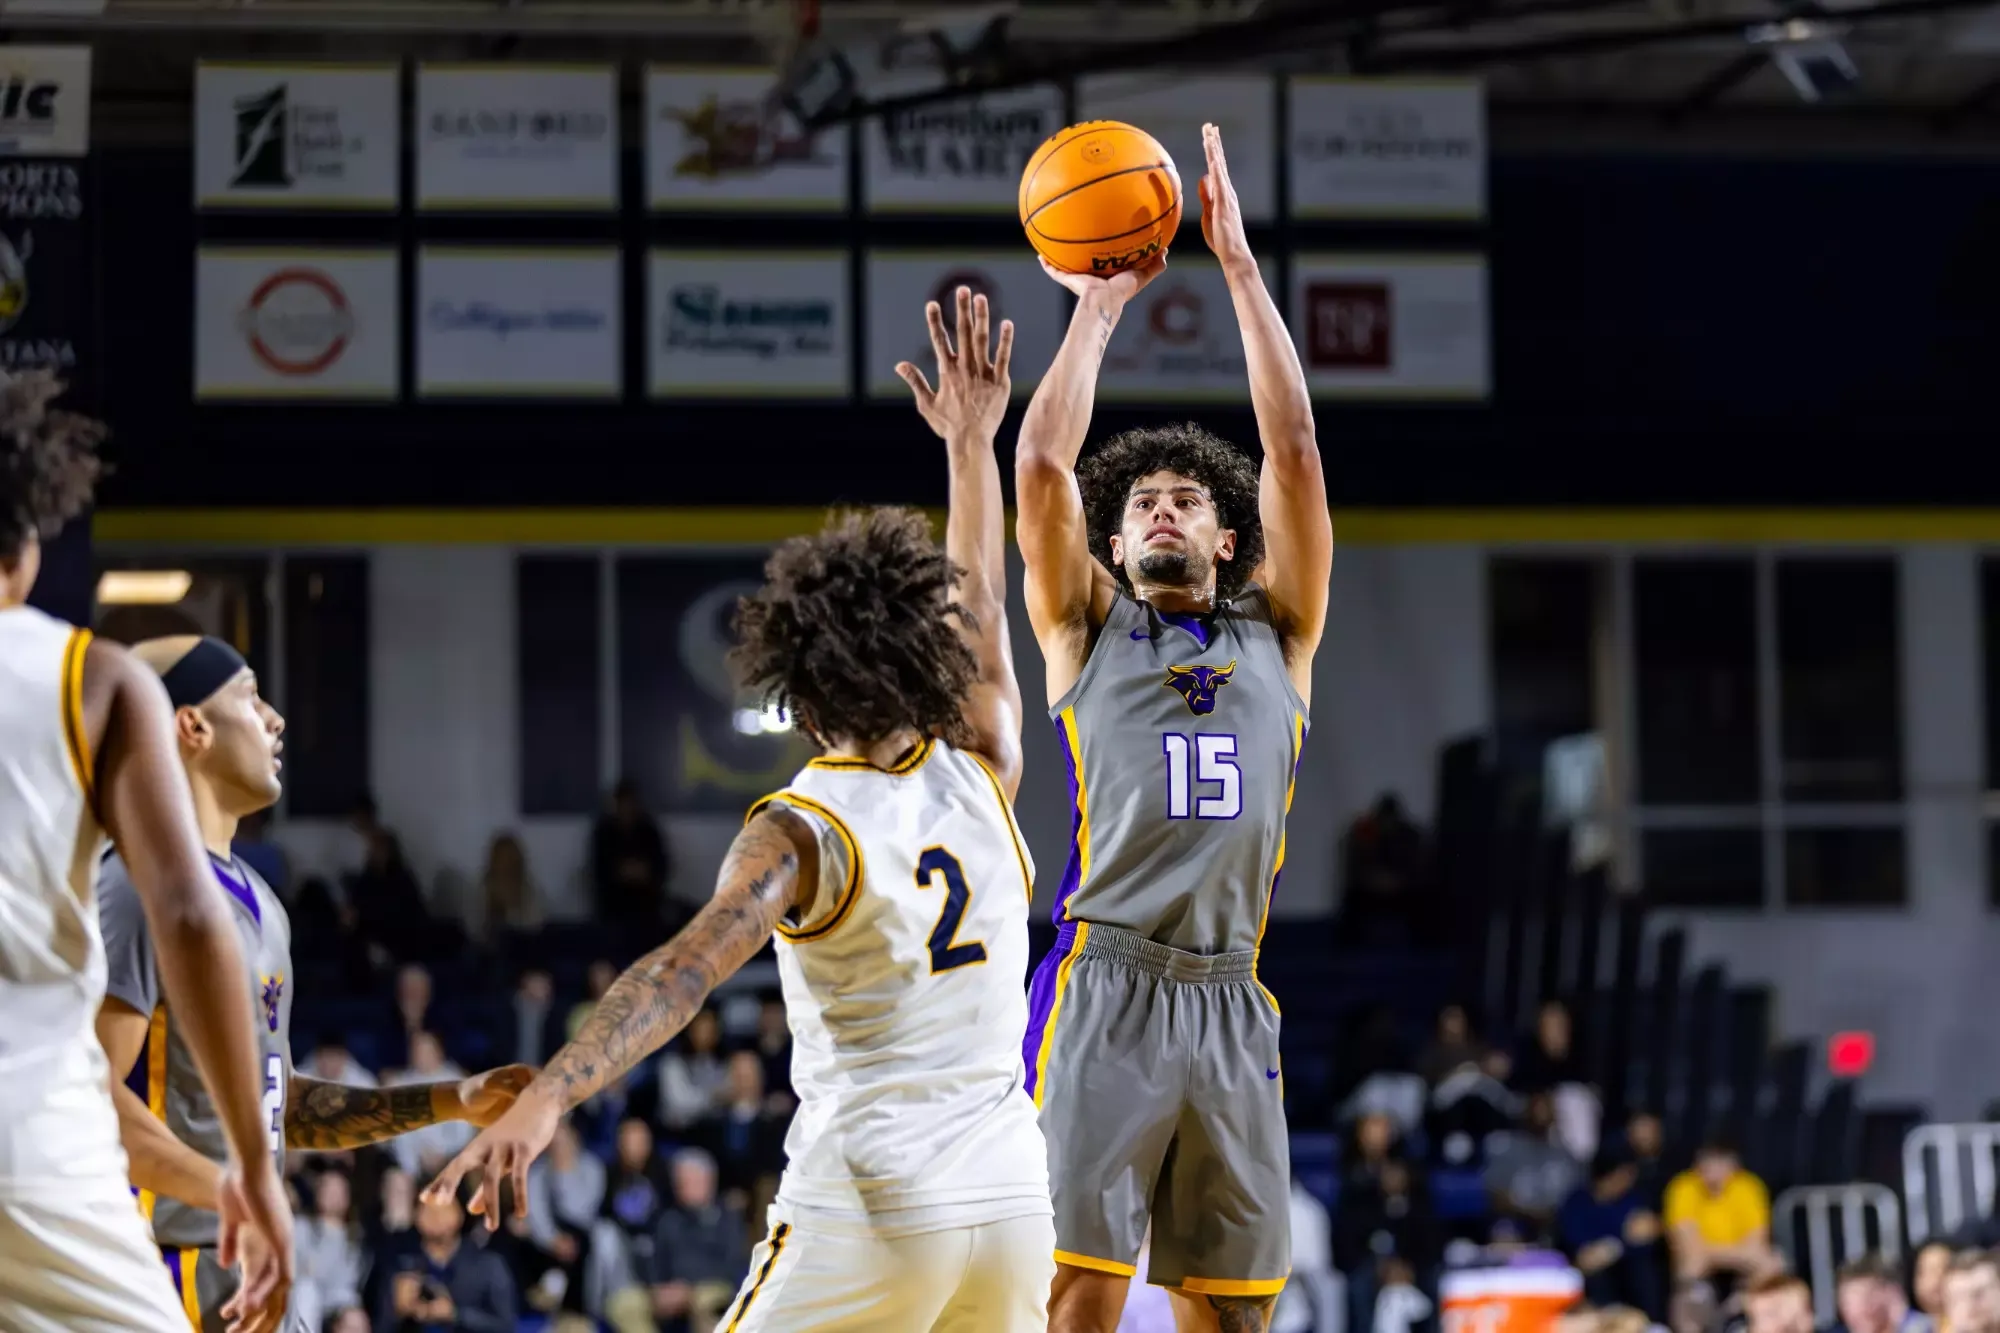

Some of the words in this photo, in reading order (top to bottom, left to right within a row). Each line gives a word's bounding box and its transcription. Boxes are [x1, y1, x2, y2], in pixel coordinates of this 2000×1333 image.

[1091, 236, 1162, 271] NCAA
[1162, 732, 1242, 820] 15
[914, 844, 988, 976] 2
